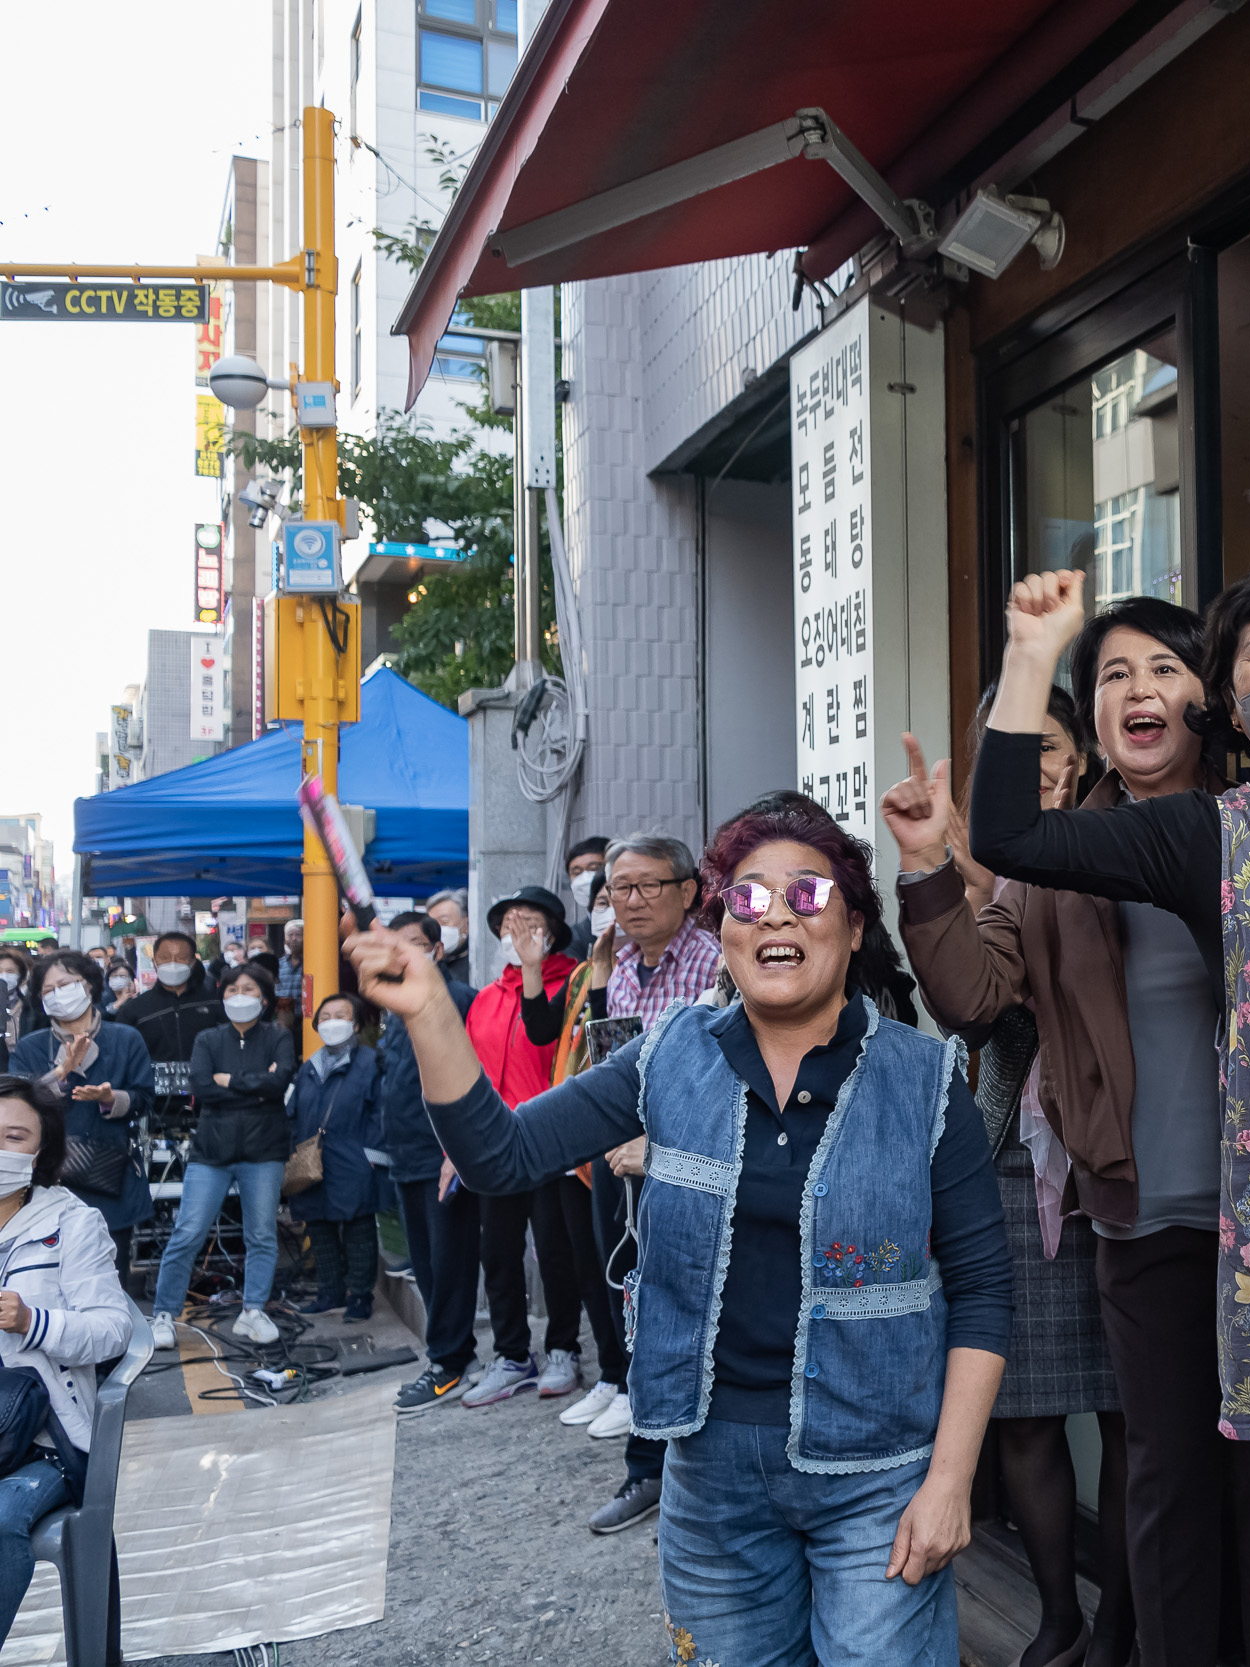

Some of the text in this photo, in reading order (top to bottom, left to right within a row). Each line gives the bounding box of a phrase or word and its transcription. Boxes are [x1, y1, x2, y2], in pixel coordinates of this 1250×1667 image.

[65, 288, 200, 317] CCTV 작동중
[796, 333, 862, 437] 녹두빈대떡
[801, 588, 867, 669] 오징어데침
